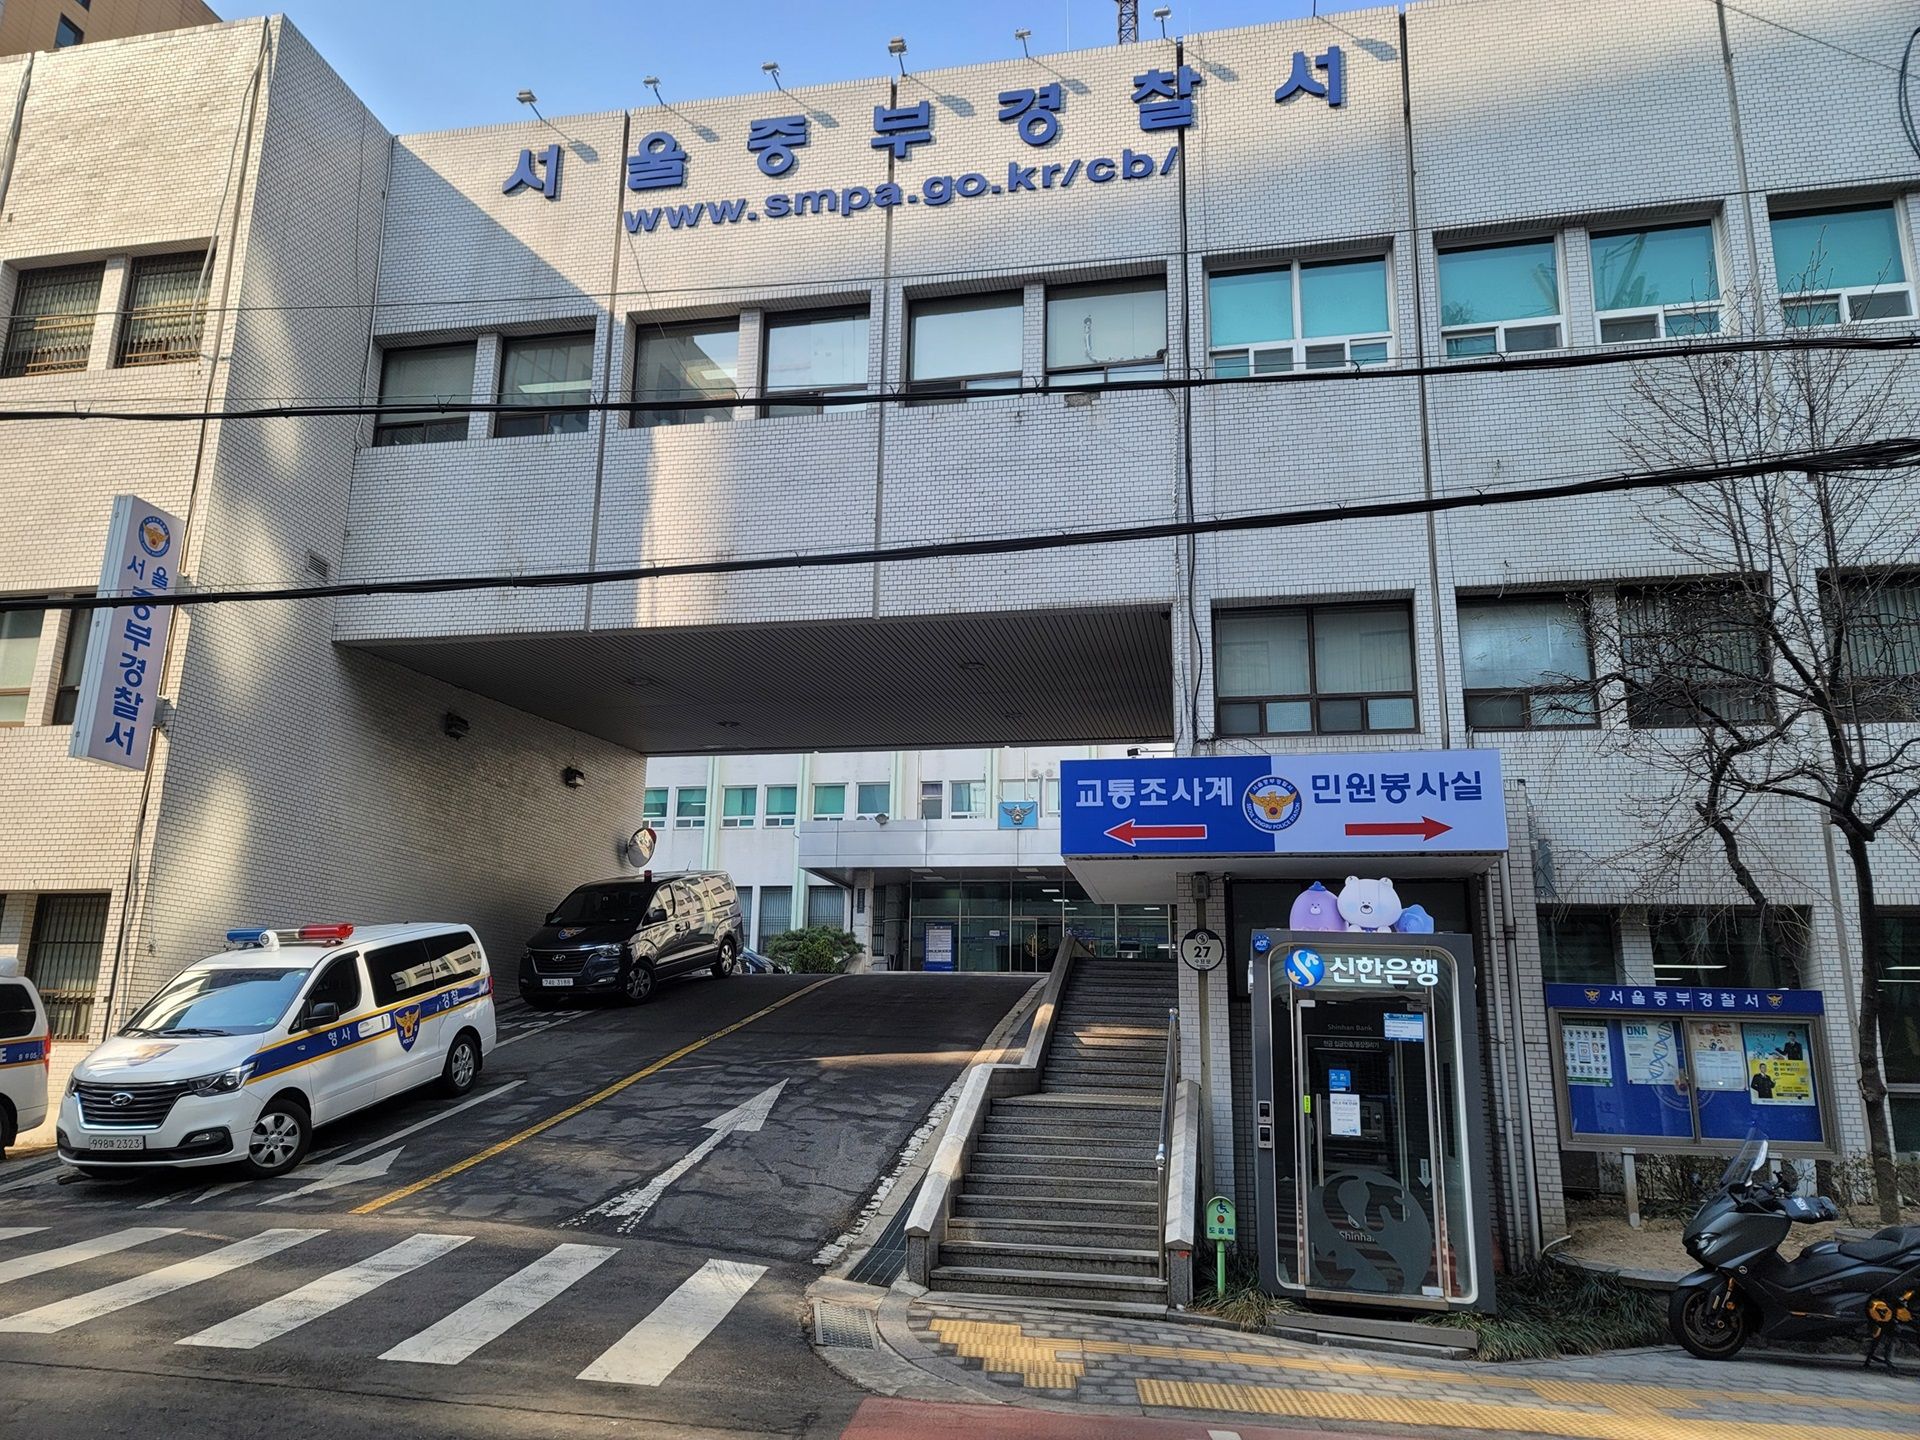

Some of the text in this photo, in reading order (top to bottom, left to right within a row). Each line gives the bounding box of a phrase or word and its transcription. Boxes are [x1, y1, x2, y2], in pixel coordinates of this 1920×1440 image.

[502, 46, 1342, 199] 서울중부경찰서
[624, 145, 1179, 233] www.smpa.go.kr/cb/
[1075, 776, 1233, 809] 교통조사계
[1311, 771, 1482, 804] 민원봉사실
[1194, 946, 1211, 958] 27
[1329, 956, 1439, 986] 신한은행
[1609, 989, 1760, 1009] 서울중부경찰서
[328, 1027, 351, 1047] 형사
[1626, 1026, 1648, 1036] DNA
[1209, 1227, 1234, 1235] 도움벨
[1339, 1231, 1376, 1242] Shinha
